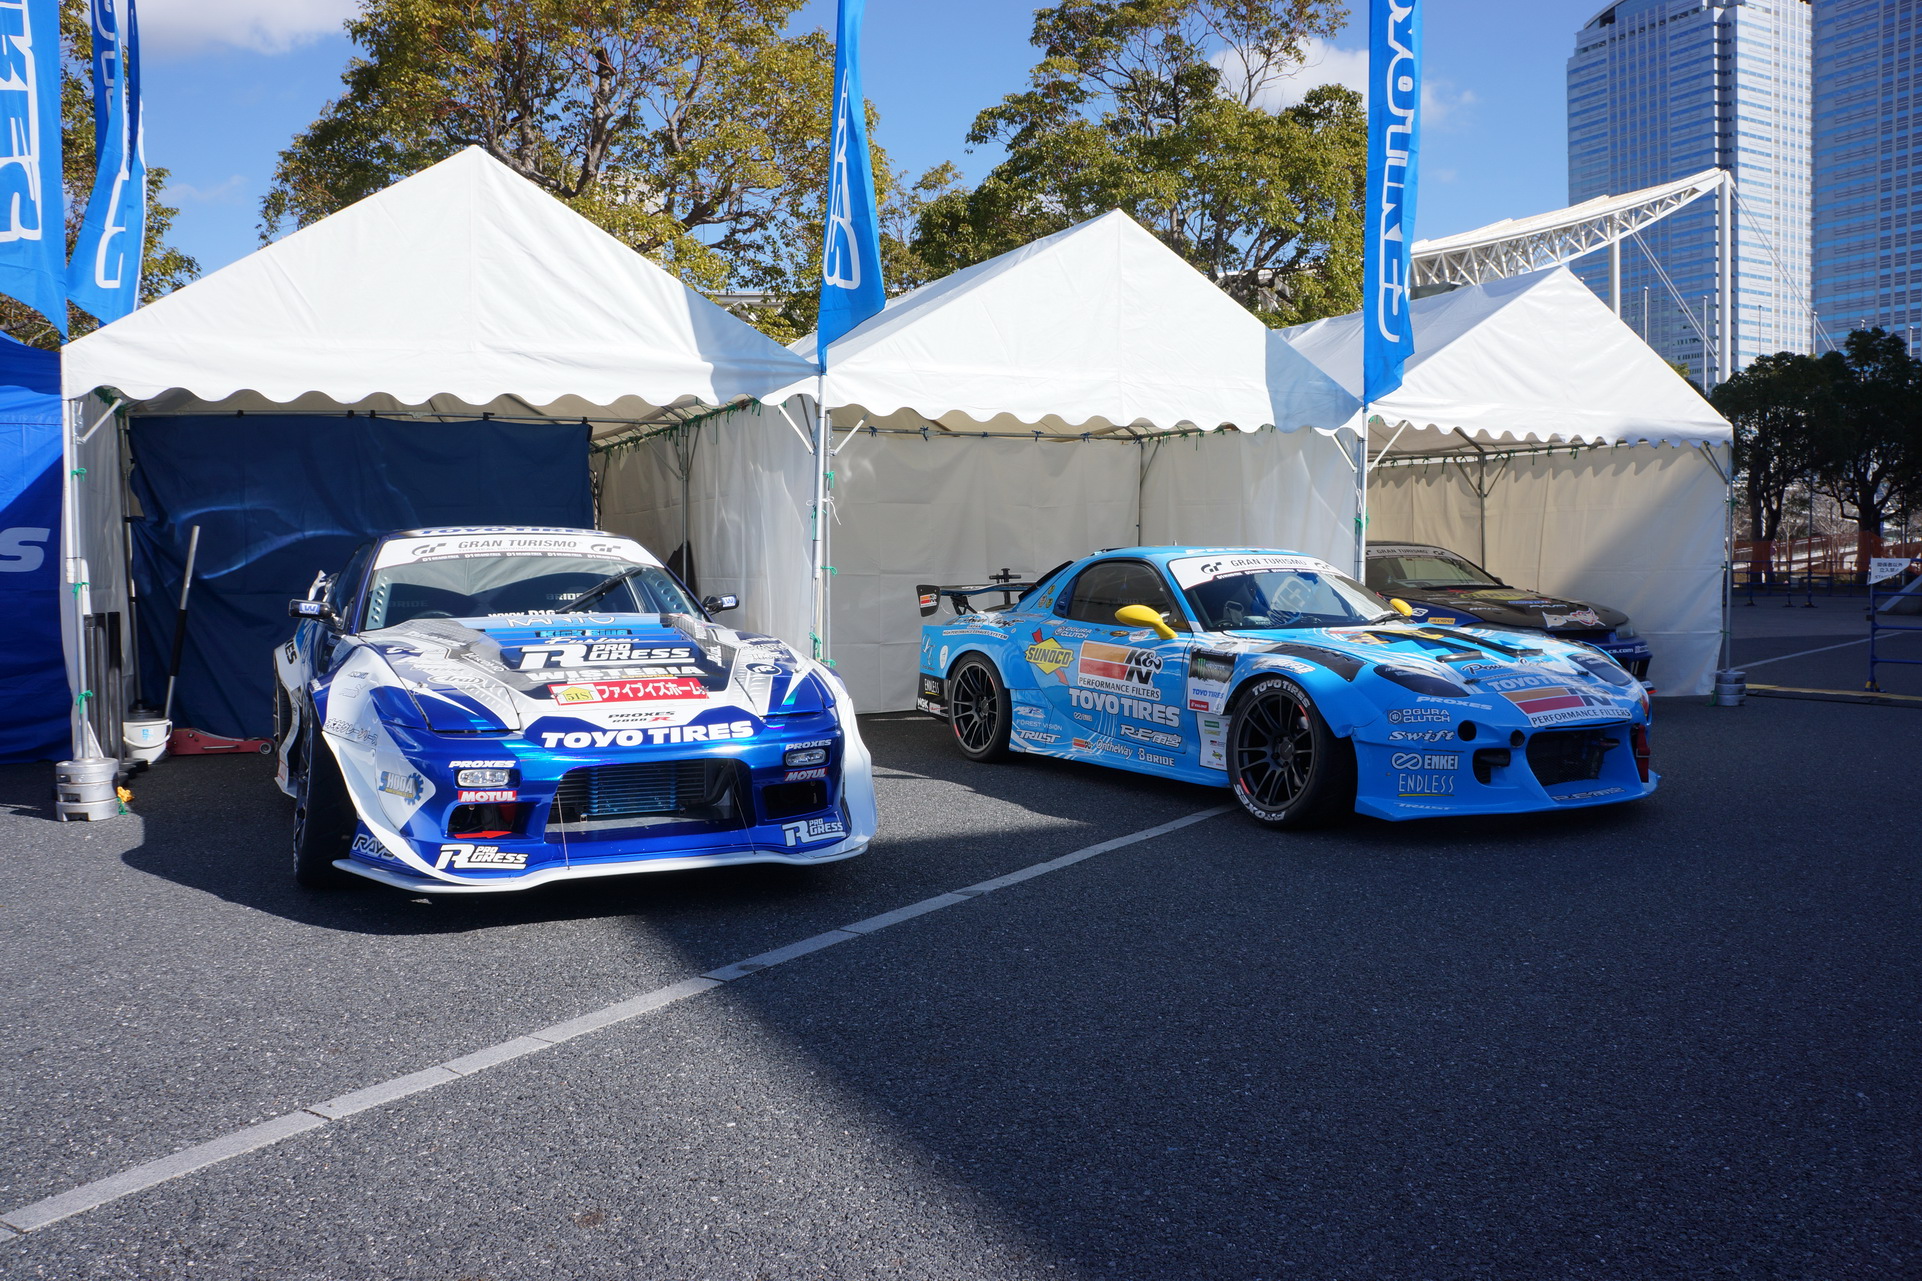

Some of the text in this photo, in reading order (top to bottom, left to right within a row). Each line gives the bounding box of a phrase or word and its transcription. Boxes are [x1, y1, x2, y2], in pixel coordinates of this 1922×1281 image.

[458, 539, 577, 549] GRAN TURISMO
[1230, 558, 1261, 567] GRAN
[1060, 630, 1088, 639] CLUTCH
[1065, 626, 1093, 634] OGURA
[588, 648, 691, 661] GRESS
[593, 644, 631, 652] PRO
[1028, 647, 1071, 665] SUNOCO
[526, 666, 706, 681] WISTERIA
[1079, 676, 1160, 699] PERFORMANCE FILTERS
[1487, 676, 1541, 691] TOYO
[1192, 688, 1207, 697] TOYO
[1252, 679, 1310, 708] TOYO TIRES
[1069, 688, 1120, 716] TOYO
[1121, 699, 1180, 728] TIRES
[1416, 696, 1493, 711] PROXES
[1532, 708, 1631, 725] PERFORMANCE FILTERS
[1016, 719, 1062, 731] FOREST VISION
[541, 721, 754, 748] TOYO TIRES
[1016, 729, 1061, 744] TRUST
[1389, 730, 1455, 743] Swift
[784, 739, 832, 751] PROXES
[449, 760, 516, 768] PROXES
[1147, 754, 1175, 767] BRIDE
[1424, 755, 1459, 770] ENKEI
[784, 769, 827, 782] MOTUL
[1398, 773, 1454, 794] ENDLESS
[460, 791, 516, 802] MOTUL
[1233, 784, 1285, 821] PROXES
[809, 818, 824, 827] PRO
[809, 822, 844, 836] GRESS
[471, 852, 529, 863] GRESS
